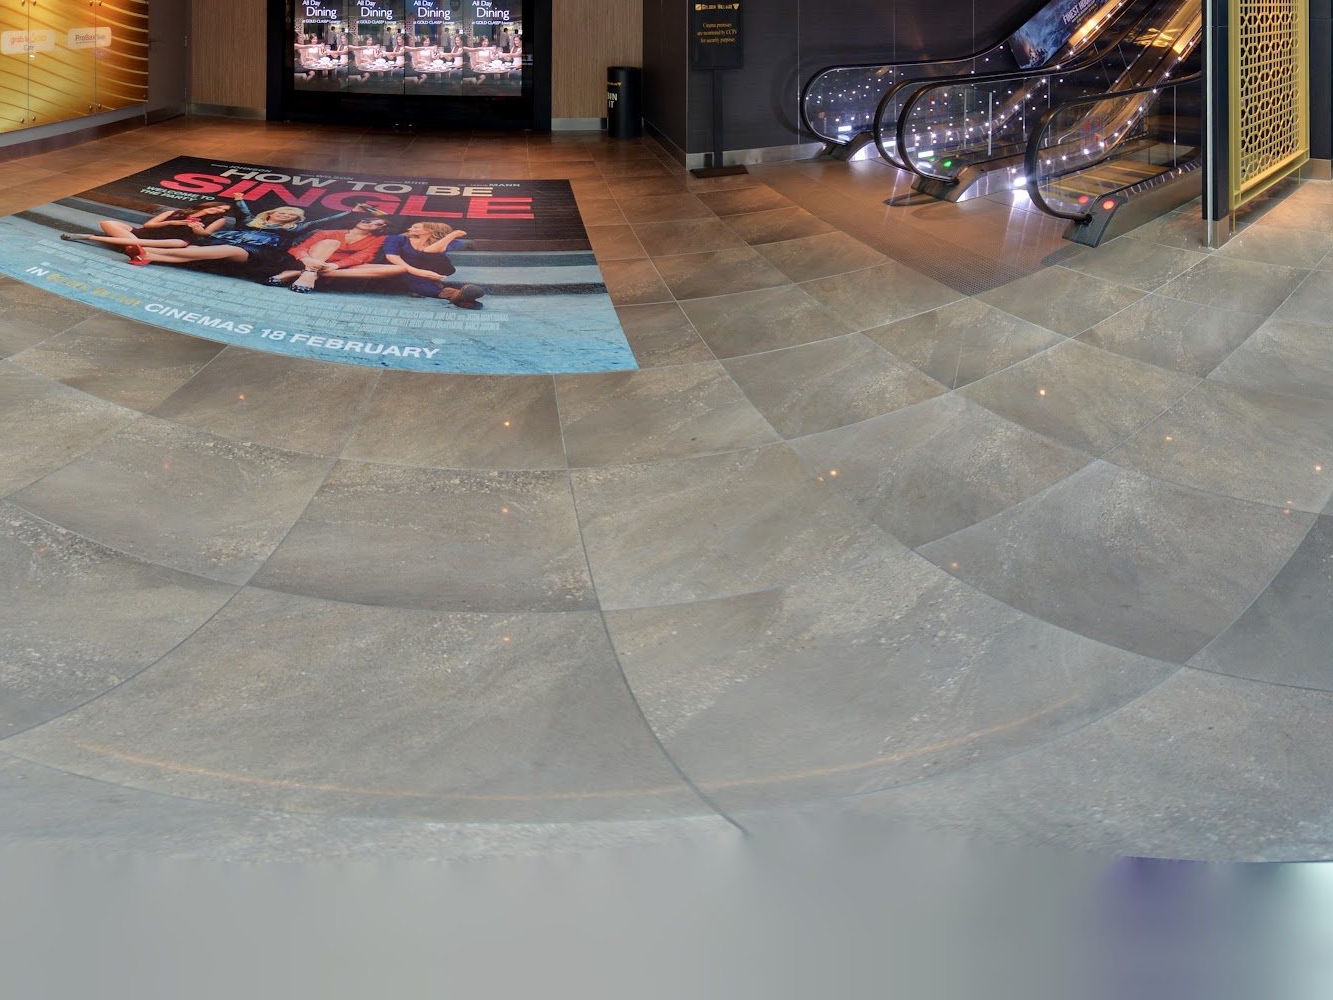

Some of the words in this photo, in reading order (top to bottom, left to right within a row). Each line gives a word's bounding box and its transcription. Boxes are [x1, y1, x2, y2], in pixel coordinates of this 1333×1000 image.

[306, 6, 337, 19] Dining
[361, 7, 393, 20] Dining
[418, 7, 450, 20] Dining
[476, 7, 510, 20] Dining
[1063, 3, 1080, 24] FINEST
[609, 100, 614, 108] IT
[220, 168, 338, 188] HOW
[342, 181, 414, 194] TO
[425, 185, 494, 198] BE
[147, 186, 200, 198] WELCOME
[159, 172, 534, 219] SINGLE
[161, 193, 198, 201] PARTY
[25, 266, 49, 277] IN
[46, 273, 90, 292] GOLDEN
[92, 286, 143, 308] VILLAGE
[144, 303, 254, 334] CINEMAS
[260, 328, 285, 341] 18
[289, 333, 441, 359] FEBRUARY
